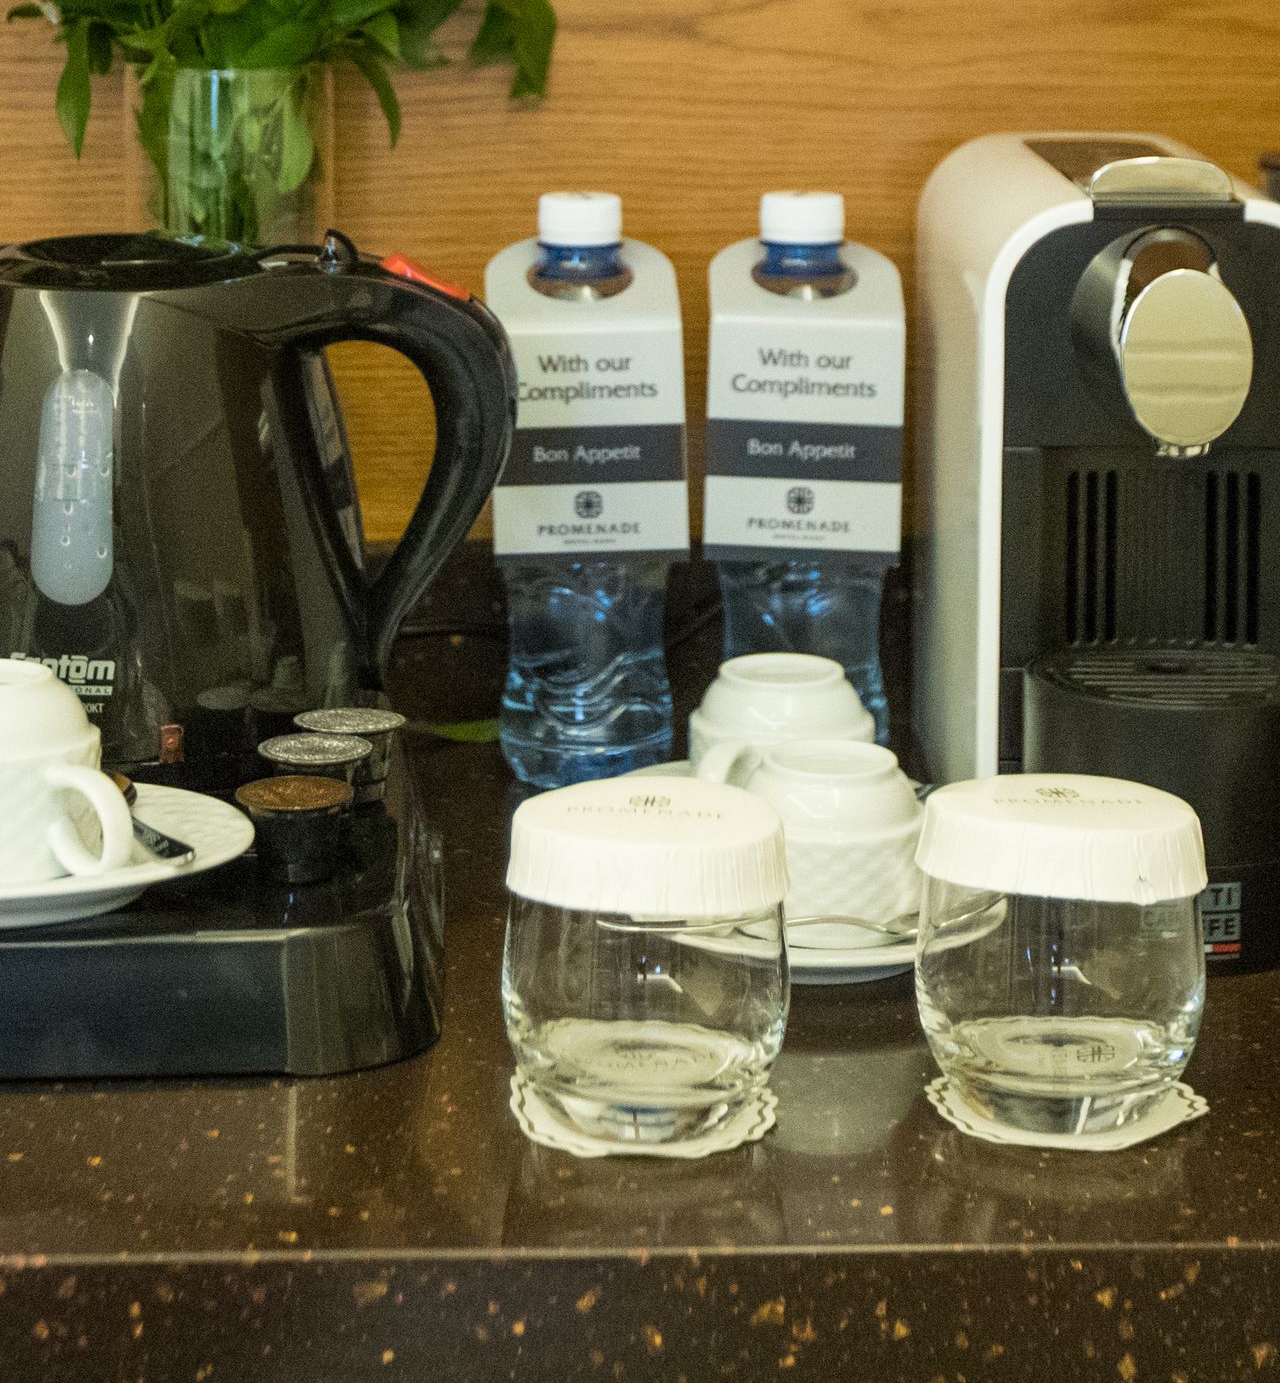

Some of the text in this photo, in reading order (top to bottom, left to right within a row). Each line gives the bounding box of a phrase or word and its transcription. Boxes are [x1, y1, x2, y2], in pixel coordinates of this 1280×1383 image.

[538, 354, 632, 374] With our
[758, 348, 853, 370] With our
[520, 381, 658, 404] Compliments
[732, 373, 878, 399] Compliments
[533, 444, 641, 465] Bon Appetit
[747, 438, 856, 462] Bon Appetit
[537, 521, 640, 536] PROMENADE
[747, 517, 851, 534] PROMENADE
[10, 653, 116, 684] ntom
[75, 686, 111, 694] ONAL
[1210, 886, 1234, 906] TI
